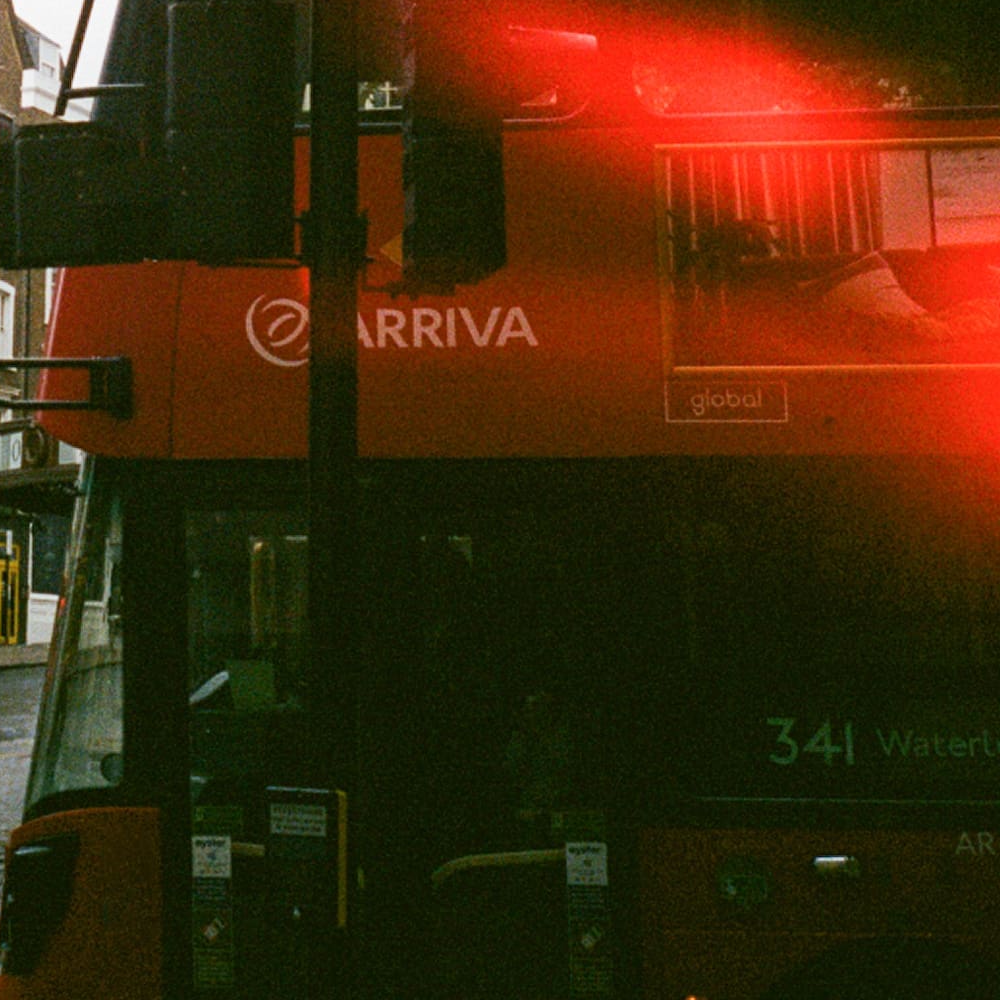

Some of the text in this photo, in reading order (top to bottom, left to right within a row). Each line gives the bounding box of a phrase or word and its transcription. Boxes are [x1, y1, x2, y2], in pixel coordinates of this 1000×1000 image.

[690, 387, 762, 416] global
[765, 716, 1000, 766] 341 Waterl
